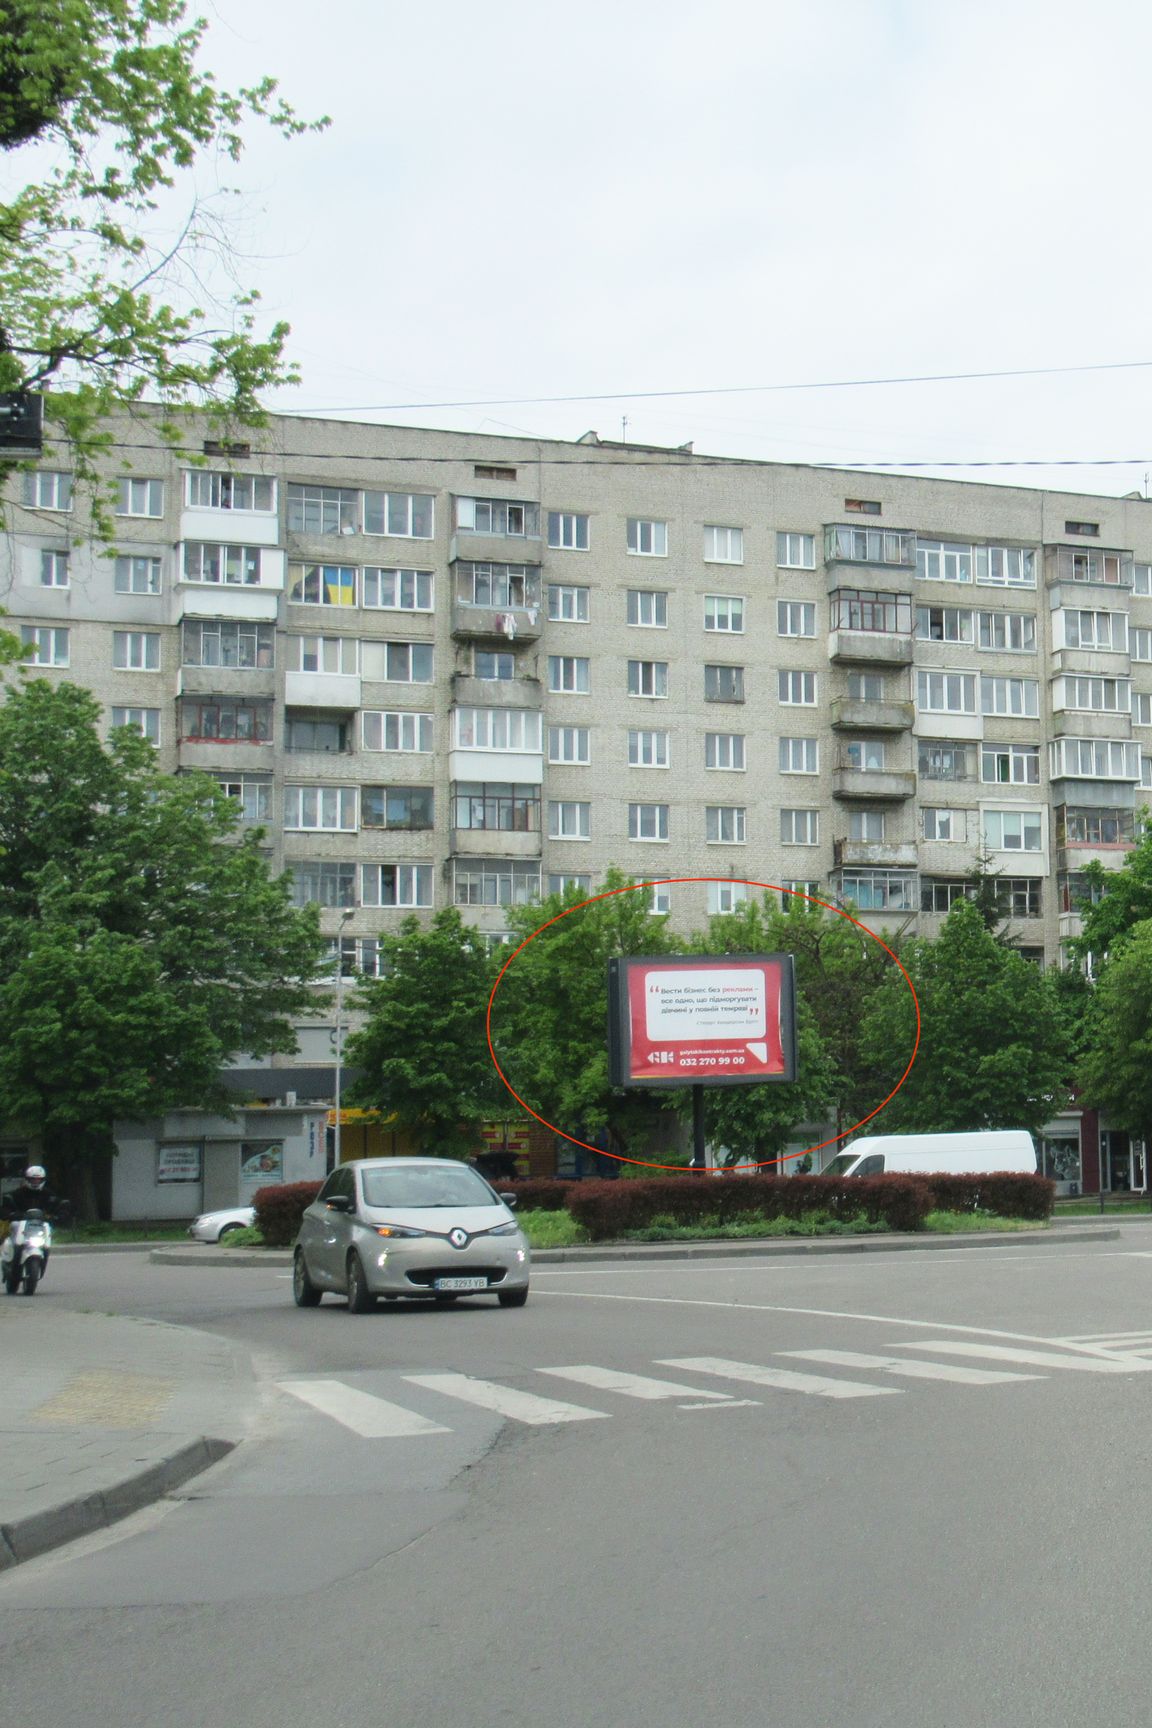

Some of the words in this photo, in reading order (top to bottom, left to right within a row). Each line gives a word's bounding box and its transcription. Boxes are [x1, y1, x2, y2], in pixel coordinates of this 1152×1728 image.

[661, 987, 682, 995] Вести
[683, 986, 706, 994] бізнес
[709, 995, 757, 1003] підморгувати
[679, 1058, 697, 1066] 032
[699, 1057, 716, 1066] 270
[718, 1056, 730, 1065] 99
[732, 1056, 745, 1064] 00
[440, 1279, 451, 1288] BC
[453, 1279, 473, 1288] 3293
